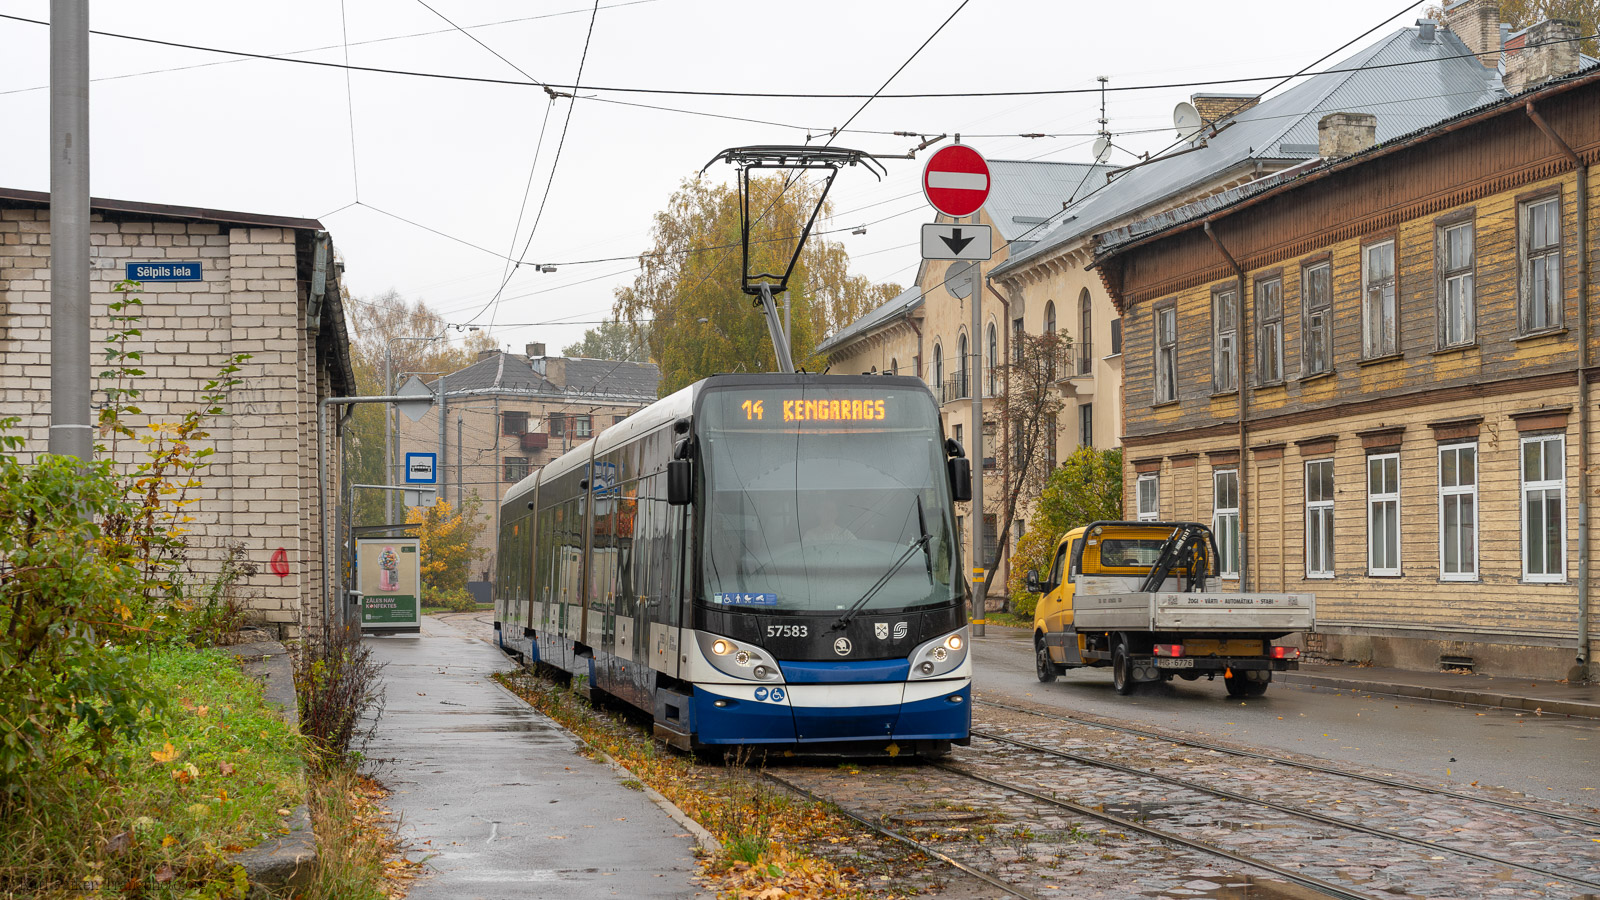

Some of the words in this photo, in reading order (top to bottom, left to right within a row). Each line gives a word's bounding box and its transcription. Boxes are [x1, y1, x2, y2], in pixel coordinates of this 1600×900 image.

[137, 266, 171, 278] Sēlpils
[173, 266, 191, 276] iela
[741, 399, 764, 420] 14
[766, 625, 808, 638] 57583
[1159, 659, 1193, 667] HG-6776
